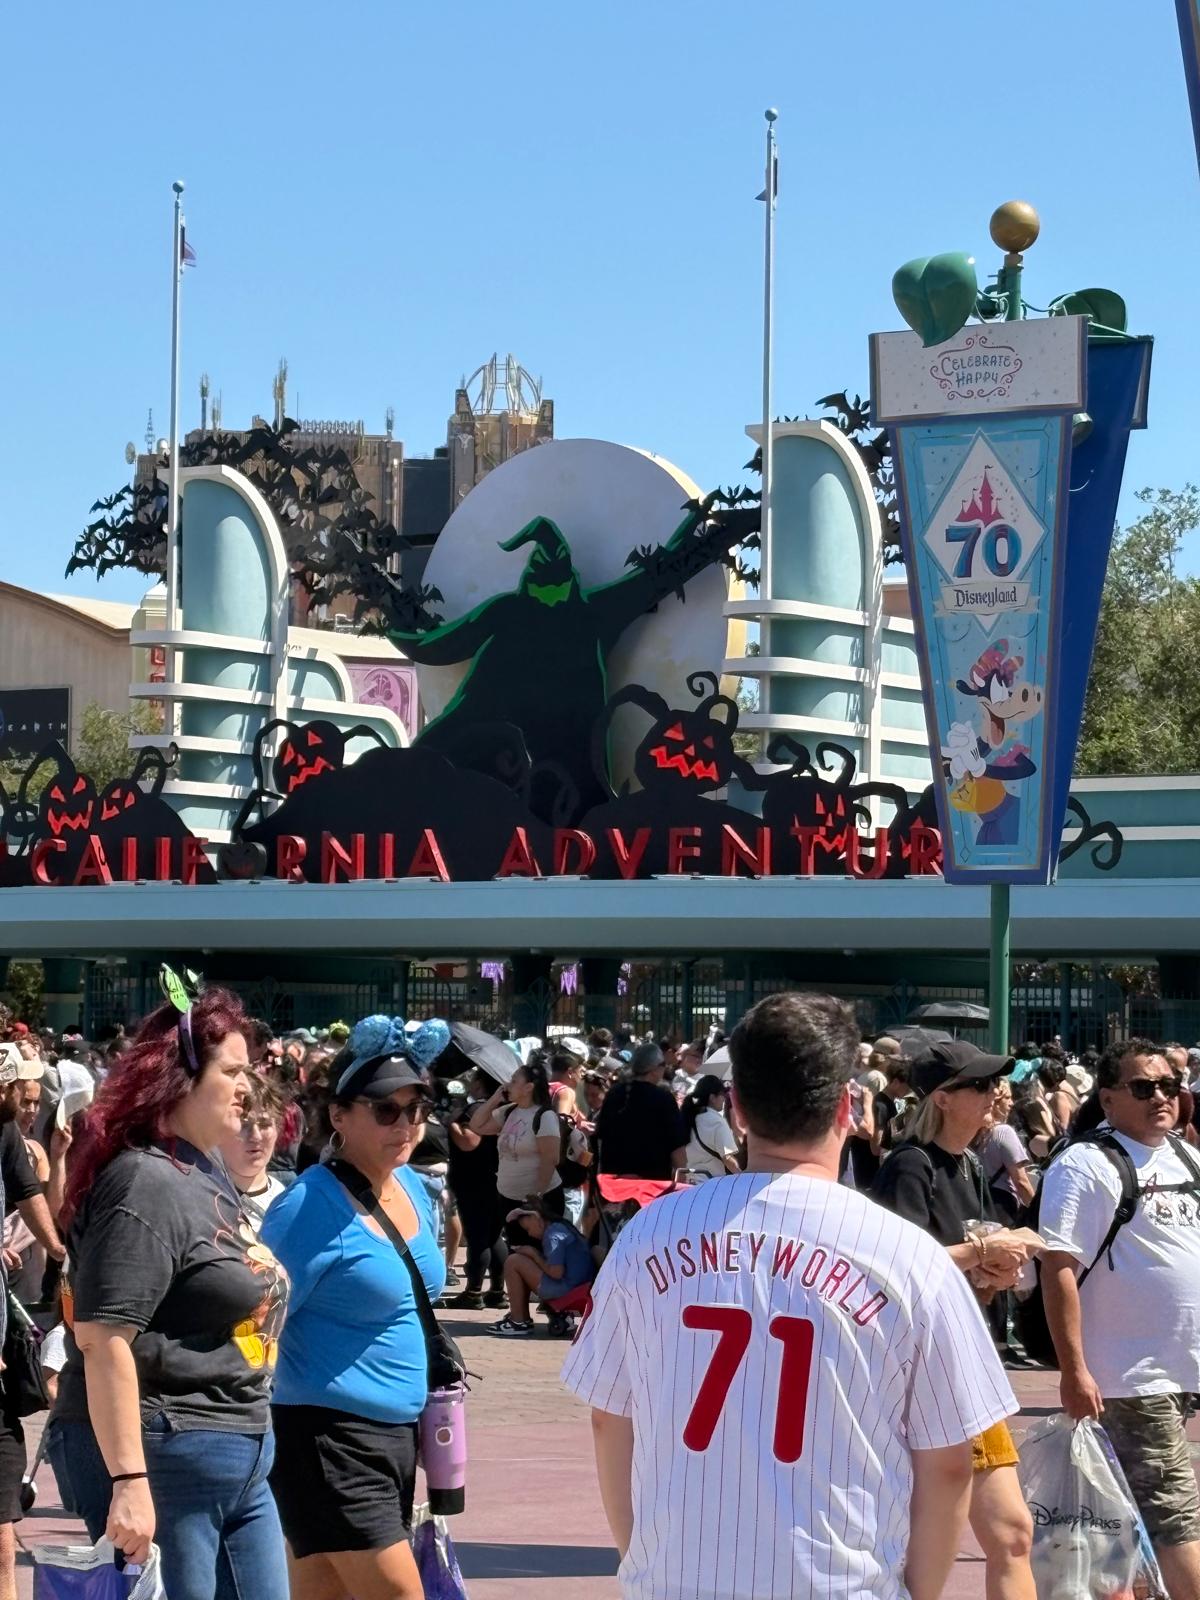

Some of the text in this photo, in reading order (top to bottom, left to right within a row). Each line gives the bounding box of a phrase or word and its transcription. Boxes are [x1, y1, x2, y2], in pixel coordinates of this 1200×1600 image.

[940, 354, 1012, 377] CELEBRATE
[955, 371, 999, 388] HAPPY
[945, 523, 1022, 578] 70
[953, 585, 1017, 608] Disneyland
[498, 822, 944, 880] ADVENTUR
[682, 1304, 815, 1464] 71
